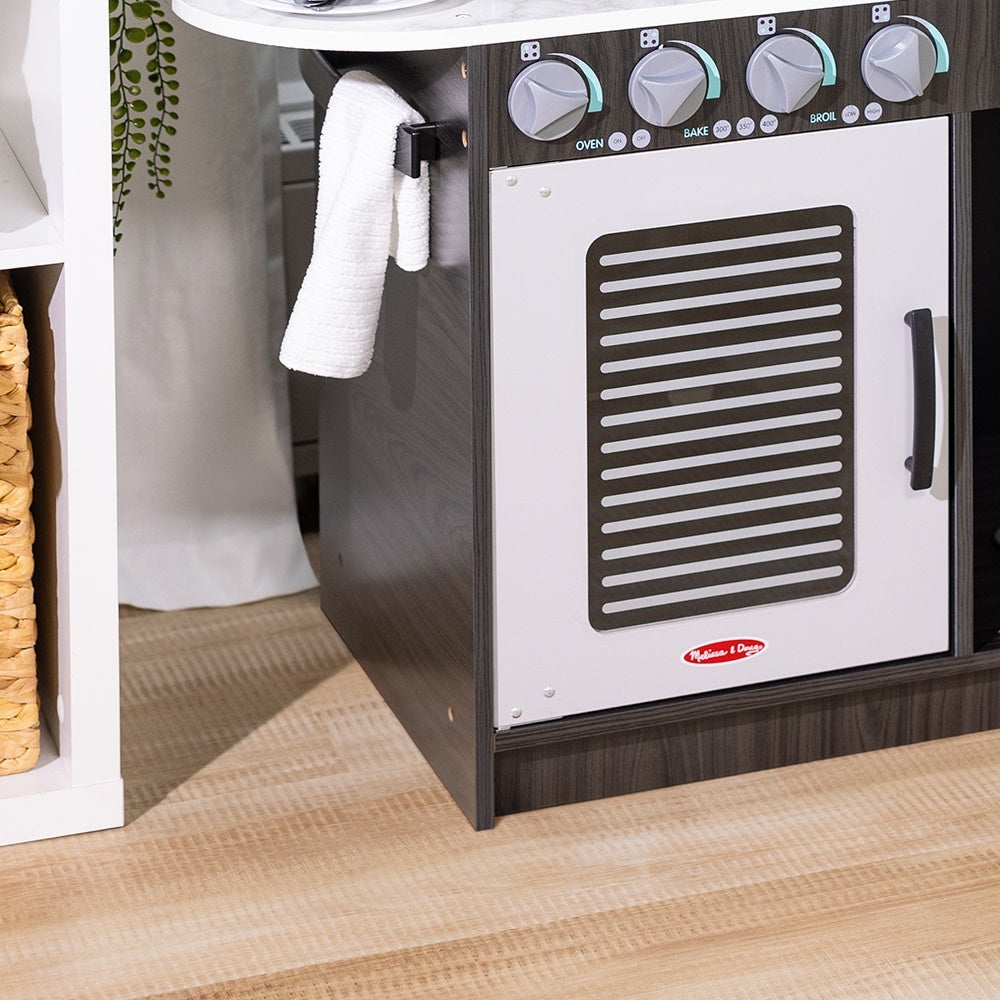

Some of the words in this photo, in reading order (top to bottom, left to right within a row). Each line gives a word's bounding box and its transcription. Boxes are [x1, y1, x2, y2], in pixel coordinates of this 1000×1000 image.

[810, 111, 837, 124] BROIL
[683, 125, 709, 139] BAKE
[575, 138, 604, 151] OVEN
[689, 648, 728, 662] Melissa
[737, 643, 763, 656] Doug
